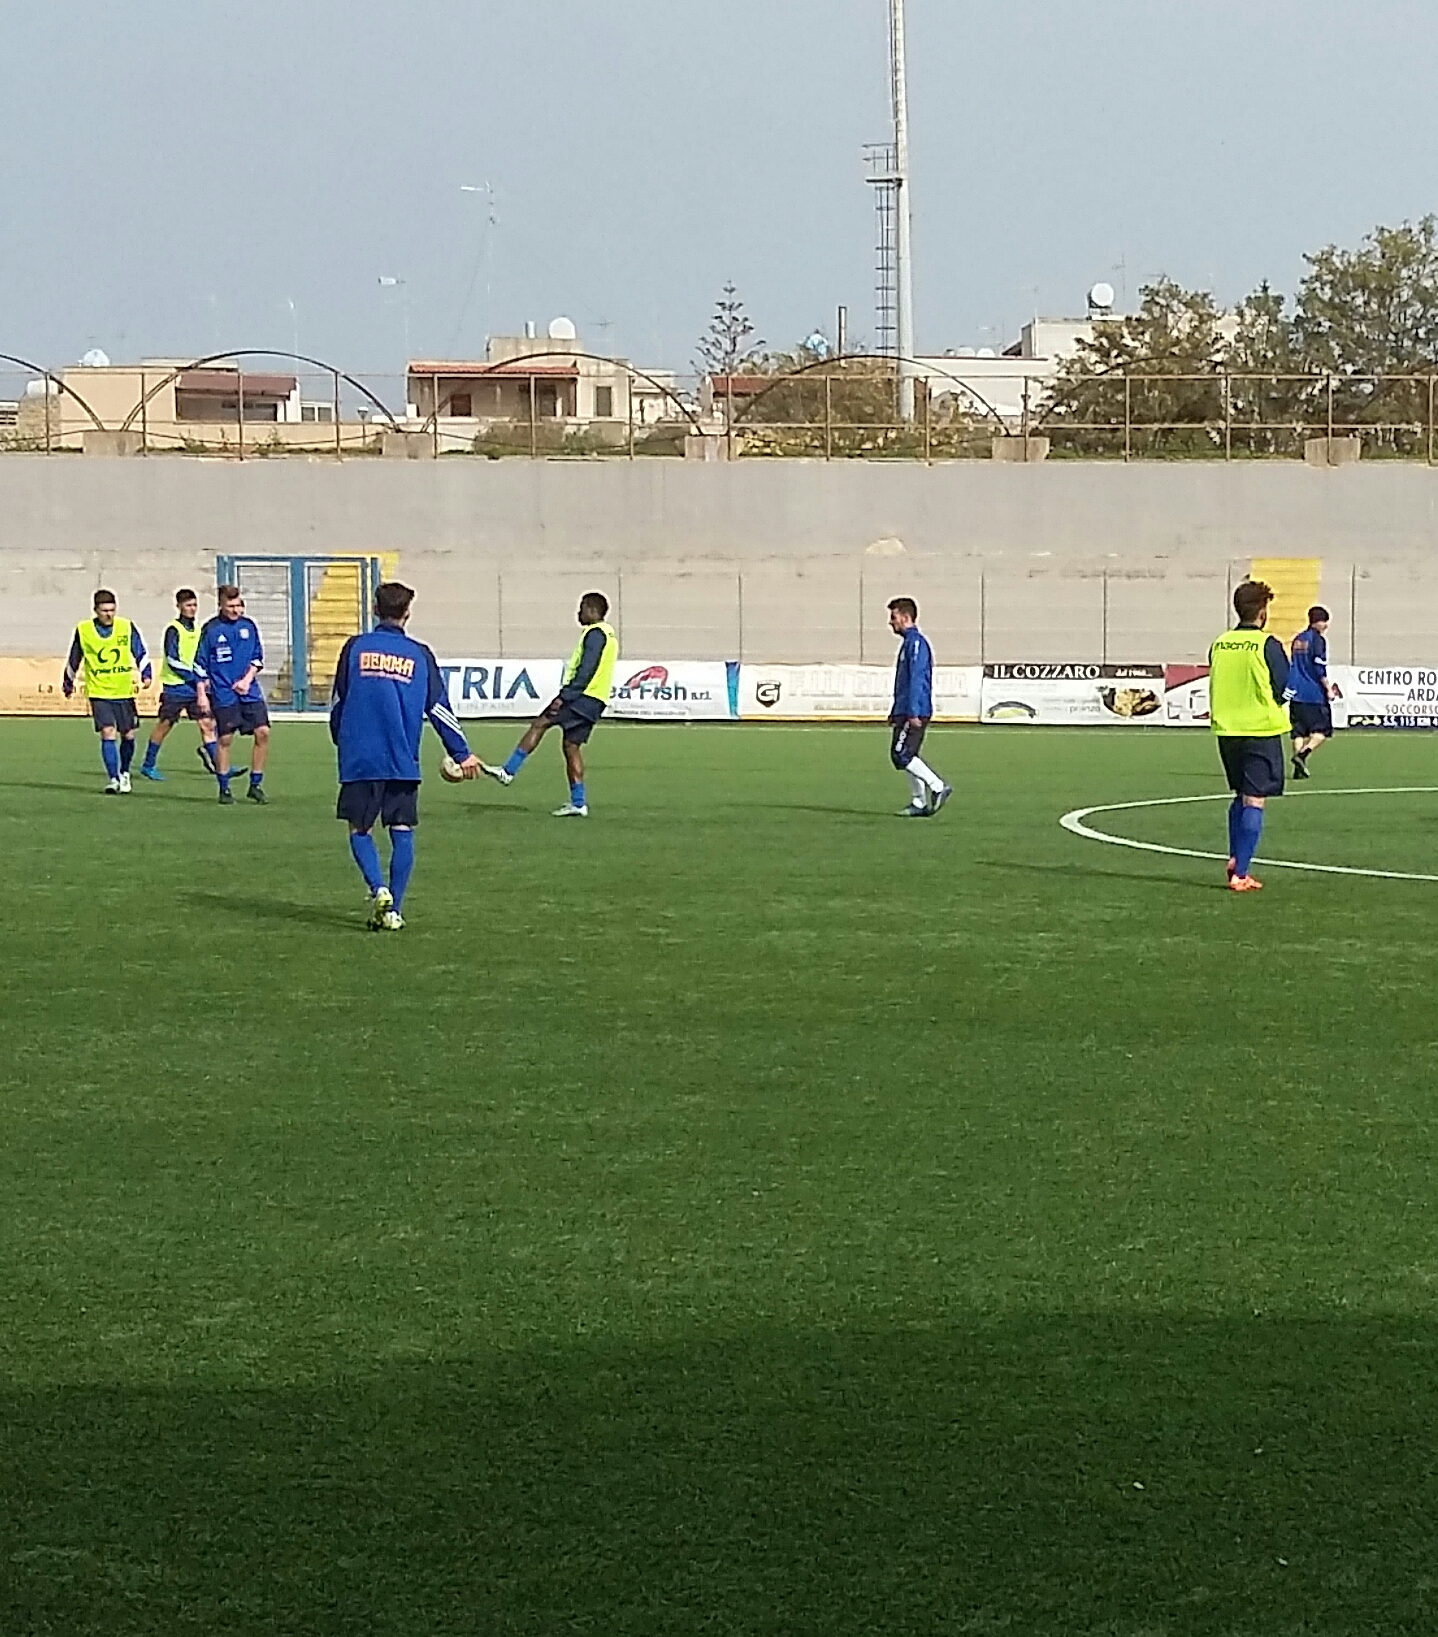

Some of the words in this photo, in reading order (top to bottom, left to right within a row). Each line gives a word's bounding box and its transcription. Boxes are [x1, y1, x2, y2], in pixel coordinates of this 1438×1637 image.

[993, 665, 1011, 679] IL
[1012, 664, 1101, 679] COZZARO
[1358, 670, 1413, 686] CENTRO
[640, 680, 687, 701] Fish
